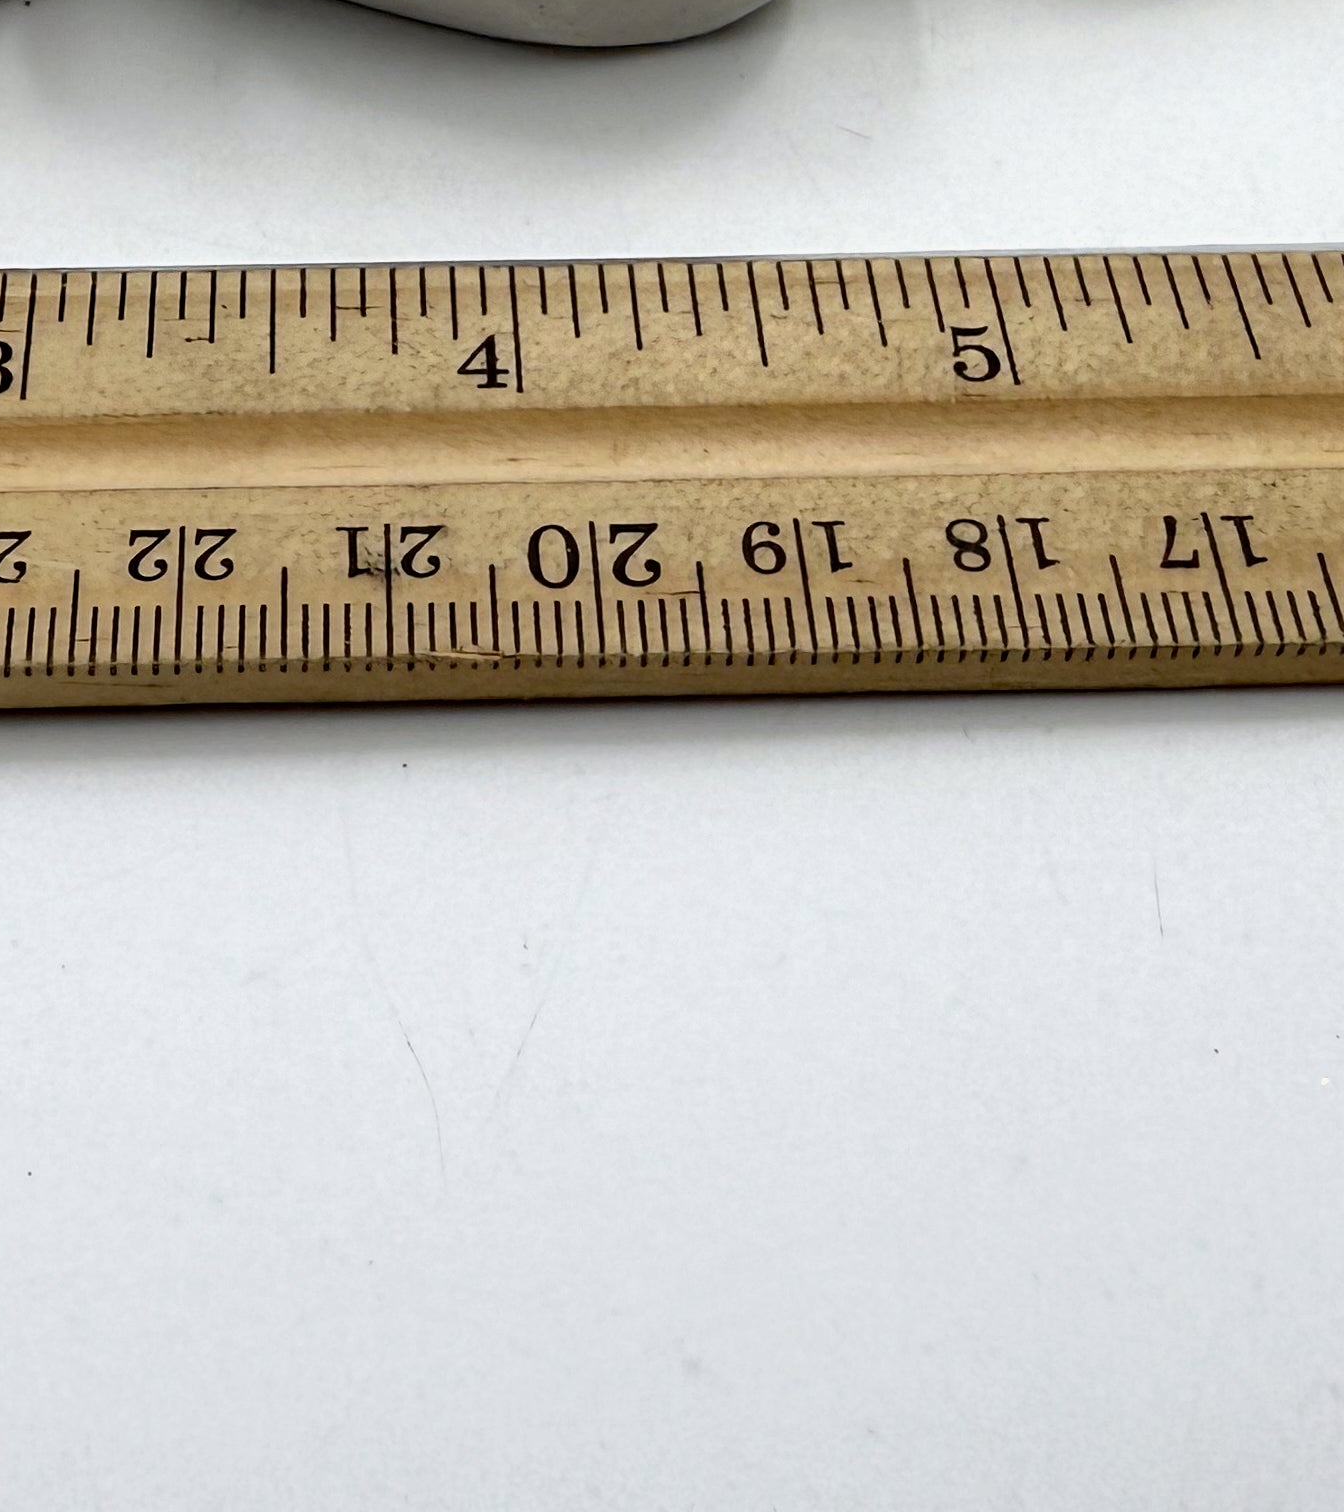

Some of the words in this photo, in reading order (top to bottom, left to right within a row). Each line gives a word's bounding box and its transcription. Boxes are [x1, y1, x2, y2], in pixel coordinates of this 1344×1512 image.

[457, 334, 510, 389] 4
[950, 326, 1001, 383] 5
[128, 529, 237, 582] 22
[335, 524, 446, 579] 21
[527, 523, 661, 589] 20
[742, 521, 853, 575] 19
[945, 517, 1060, 572] 18
[1160, 515, 1268, 569] 17
